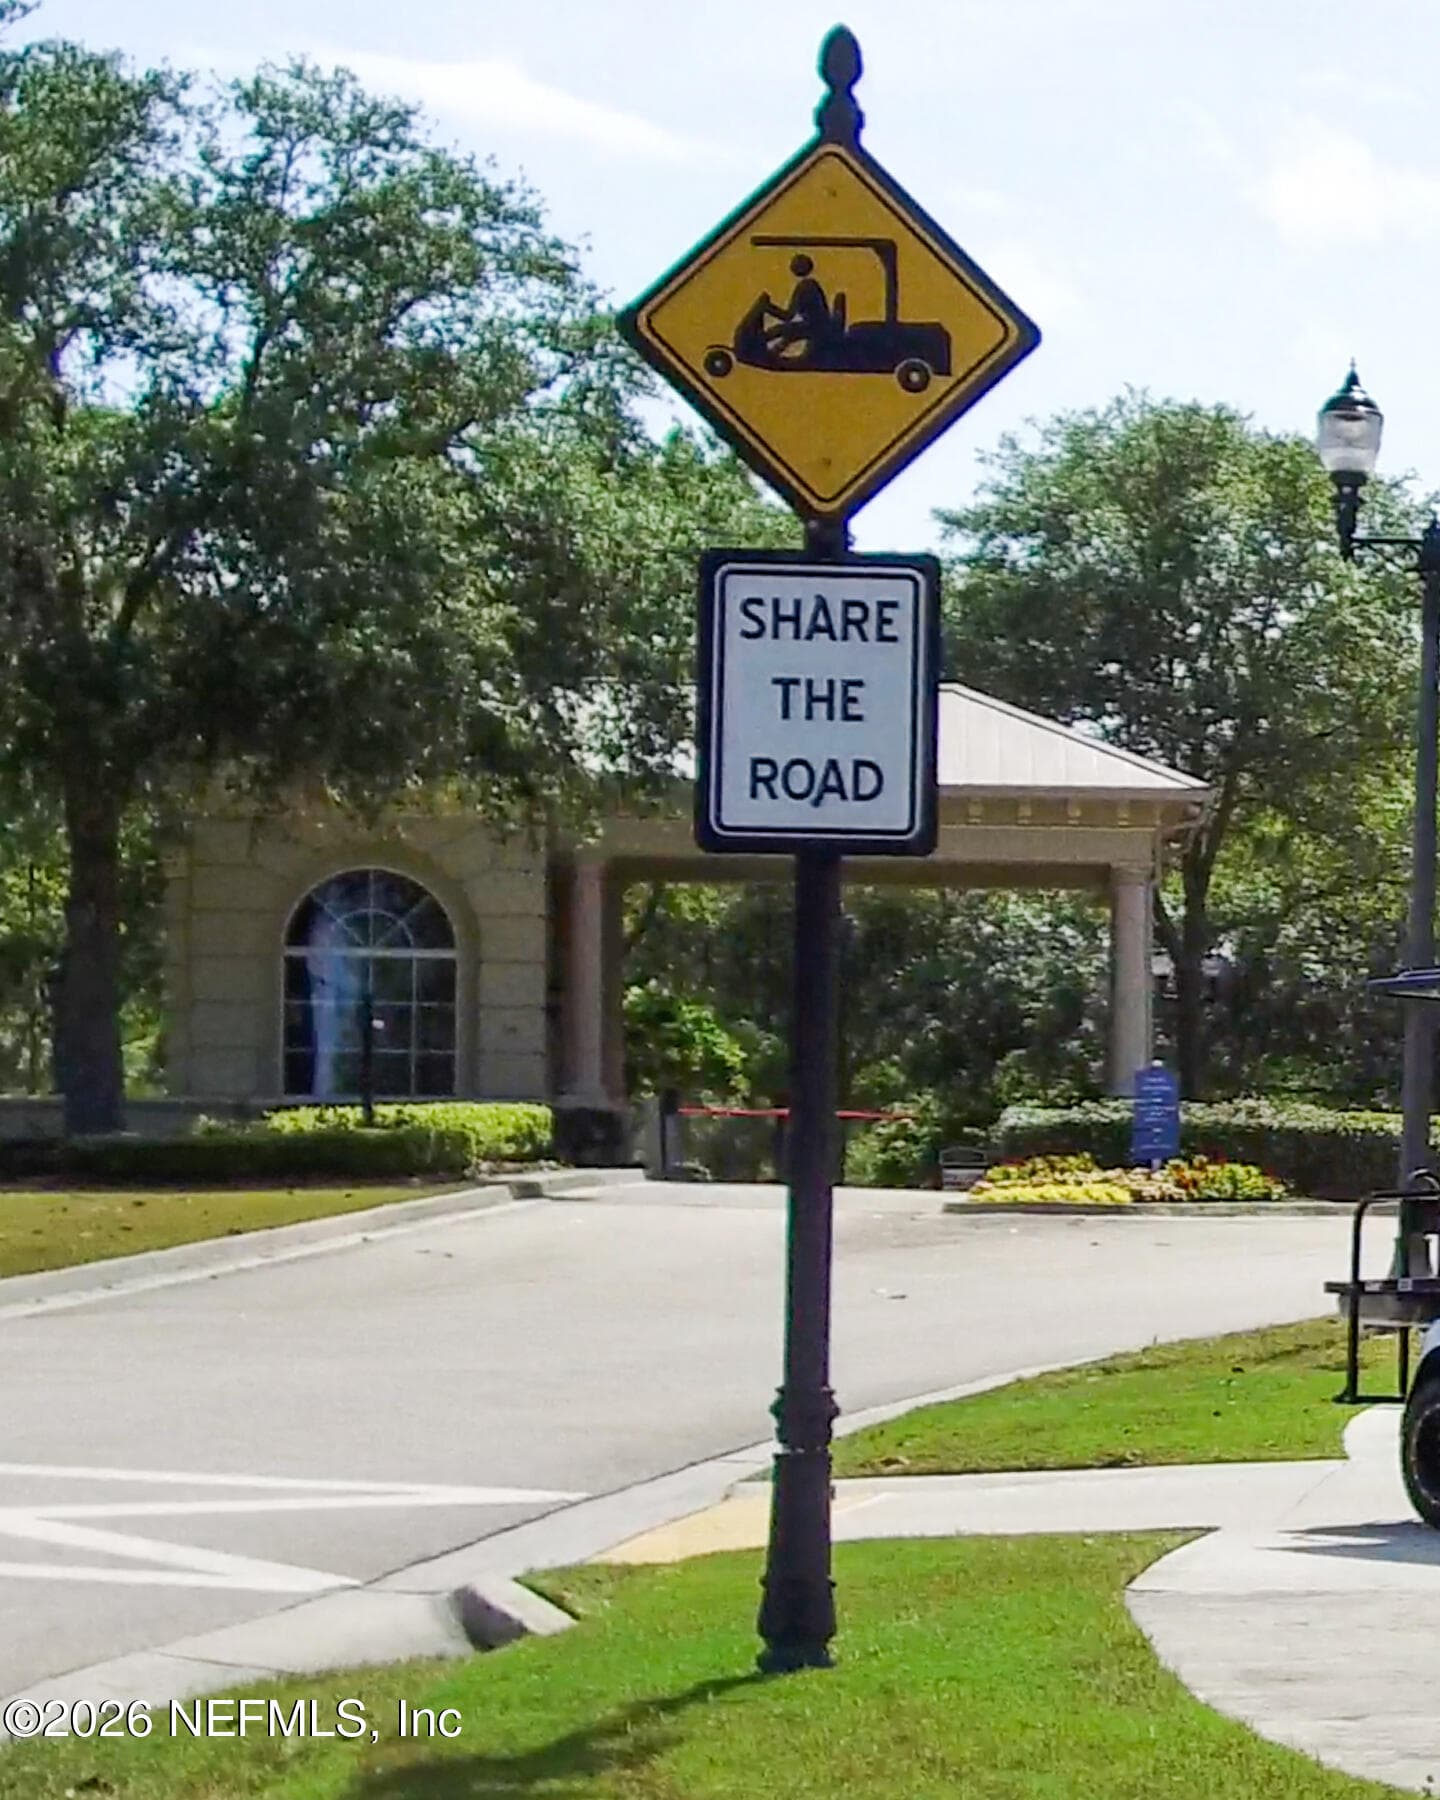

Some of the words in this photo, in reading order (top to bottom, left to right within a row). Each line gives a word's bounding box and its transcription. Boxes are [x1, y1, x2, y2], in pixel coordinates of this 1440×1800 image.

[738, 594, 900, 643] SHARE
[771, 677, 866, 722] THE
[749, 756, 885, 808] ROAD
